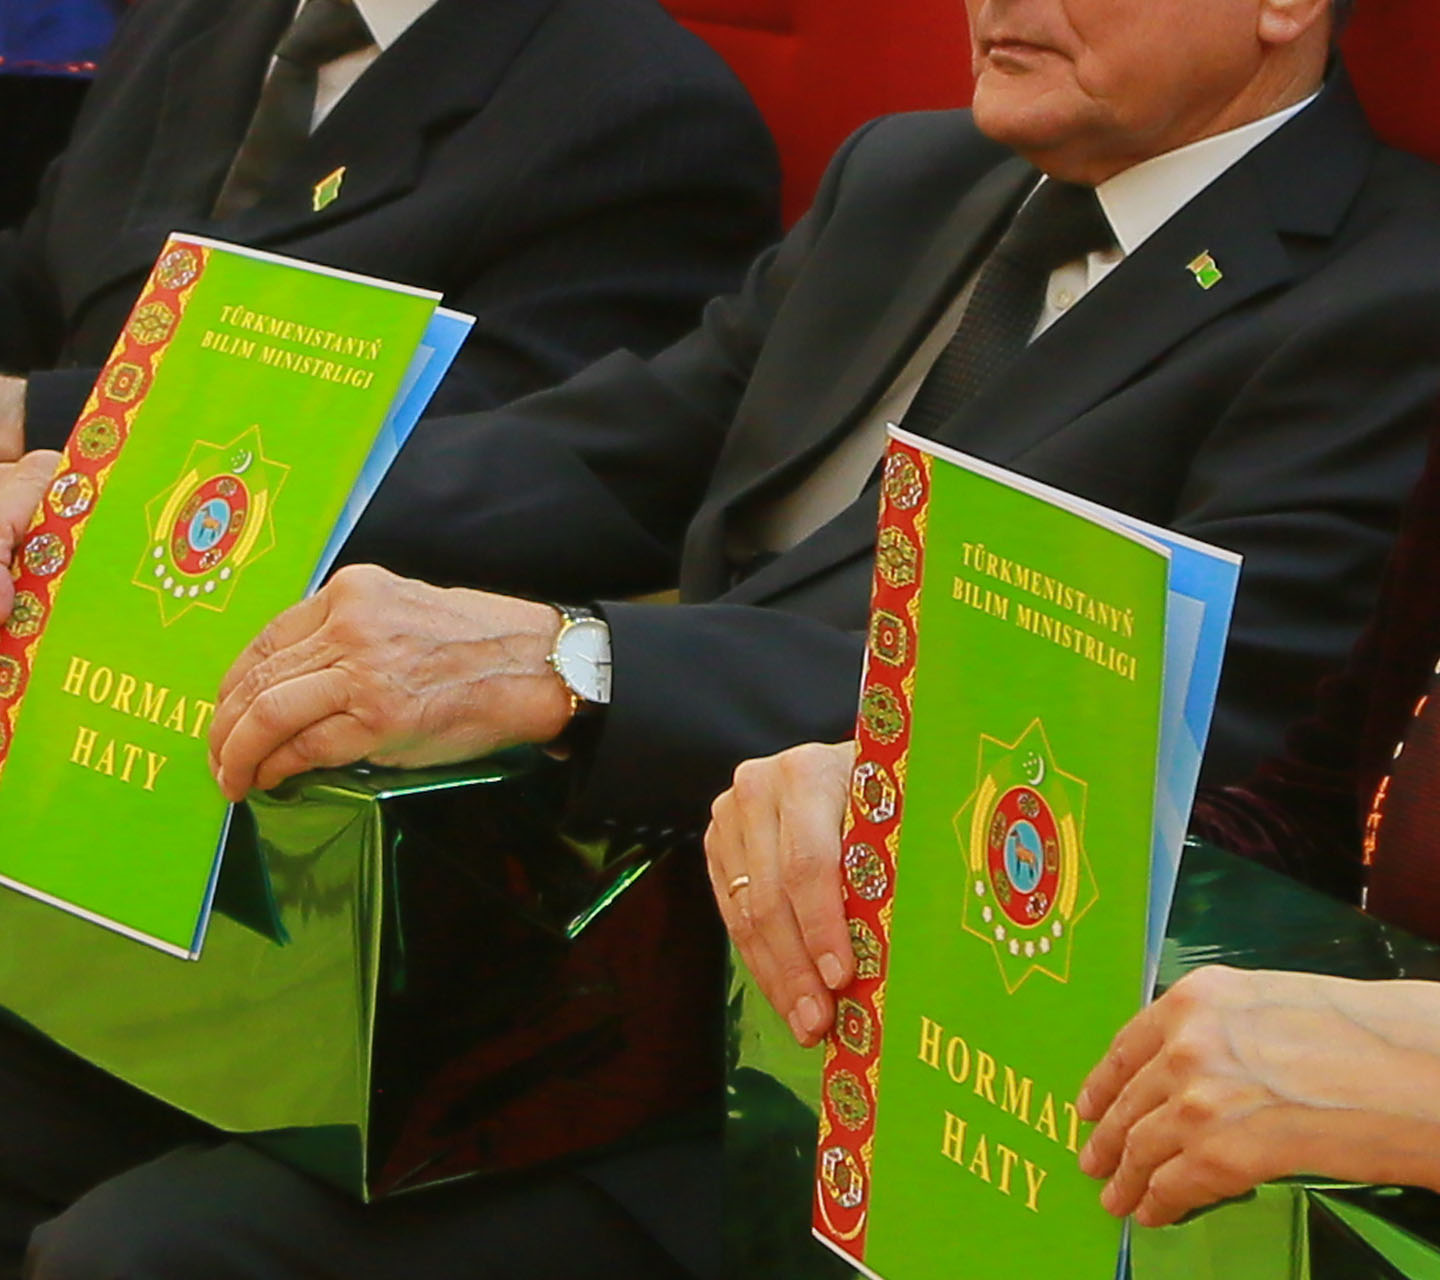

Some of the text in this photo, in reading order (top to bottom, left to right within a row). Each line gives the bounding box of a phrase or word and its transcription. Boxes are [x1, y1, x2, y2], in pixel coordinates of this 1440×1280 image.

[201, 330, 375, 390] BILIM MINISTRLIGI
[952, 576, 1137, 681] BILIM MINISTRLIGI
[962, 542, 1135, 639] TÜRKMENISTANYŇ
[61, 655, 216, 739] HORMAT
[70, 725, 168, 792] HATY
[917, 1015, 1086, 1155] HORMAT
[941, 1109, 1048, 1214] HATY
